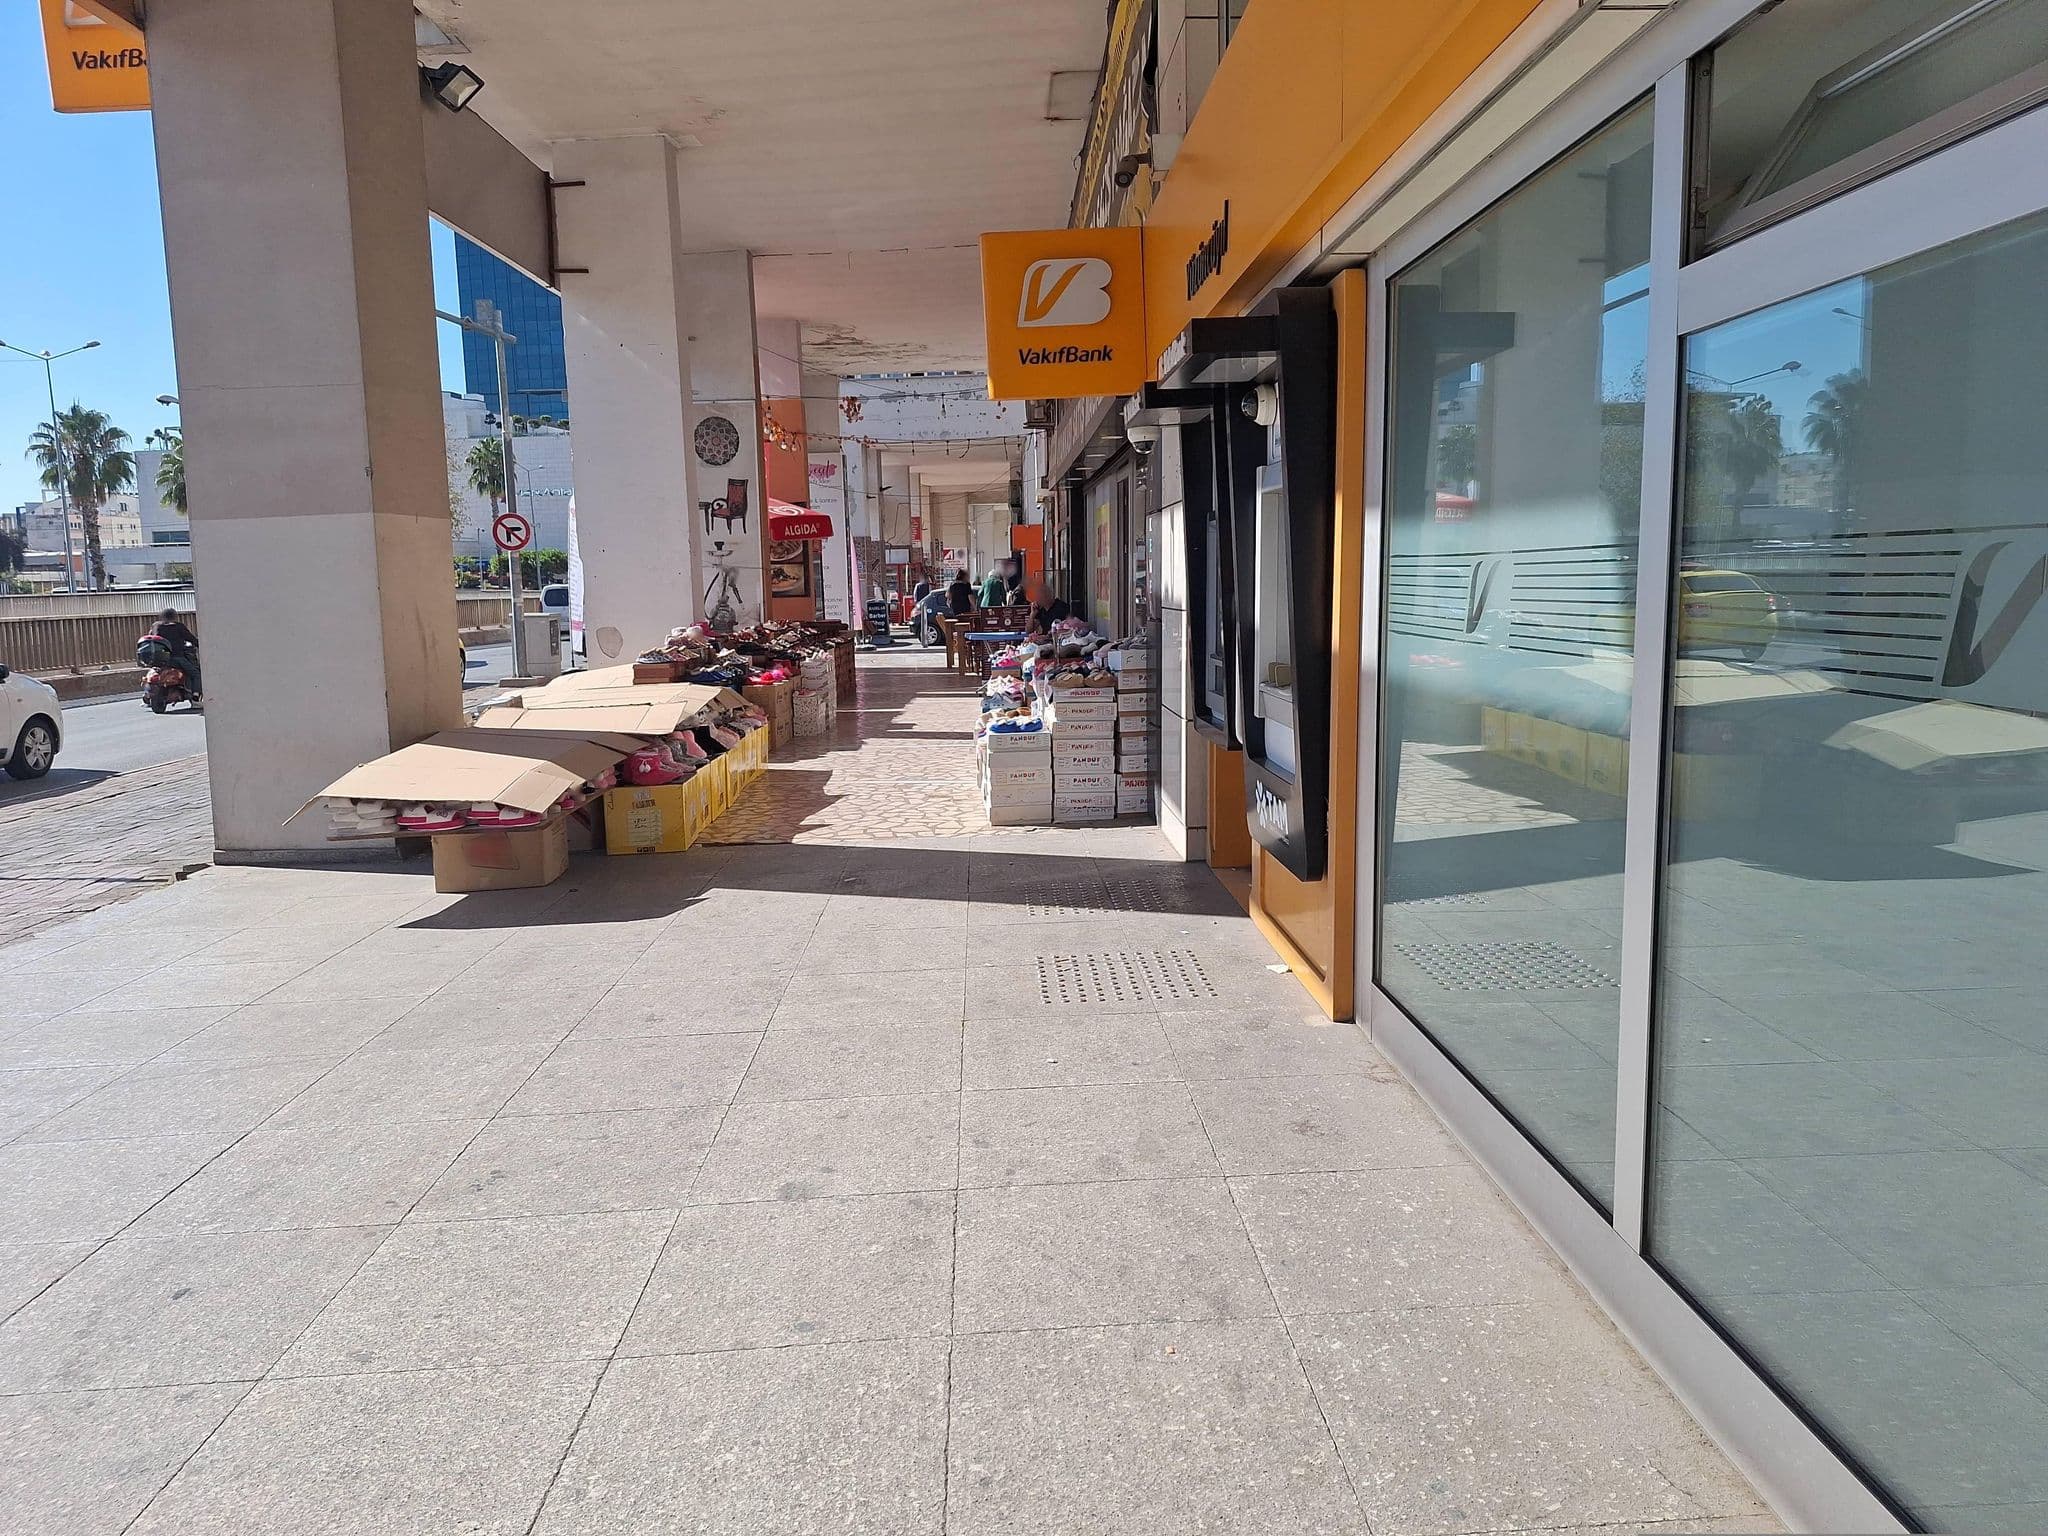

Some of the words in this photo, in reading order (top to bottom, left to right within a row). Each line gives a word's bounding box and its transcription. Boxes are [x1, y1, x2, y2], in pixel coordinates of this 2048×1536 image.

[72, 48, 147, 70] VakıfB
[1018, 344, 1113, 366] VakıfBank
[784, 523, 818, 537] ALGIDA
